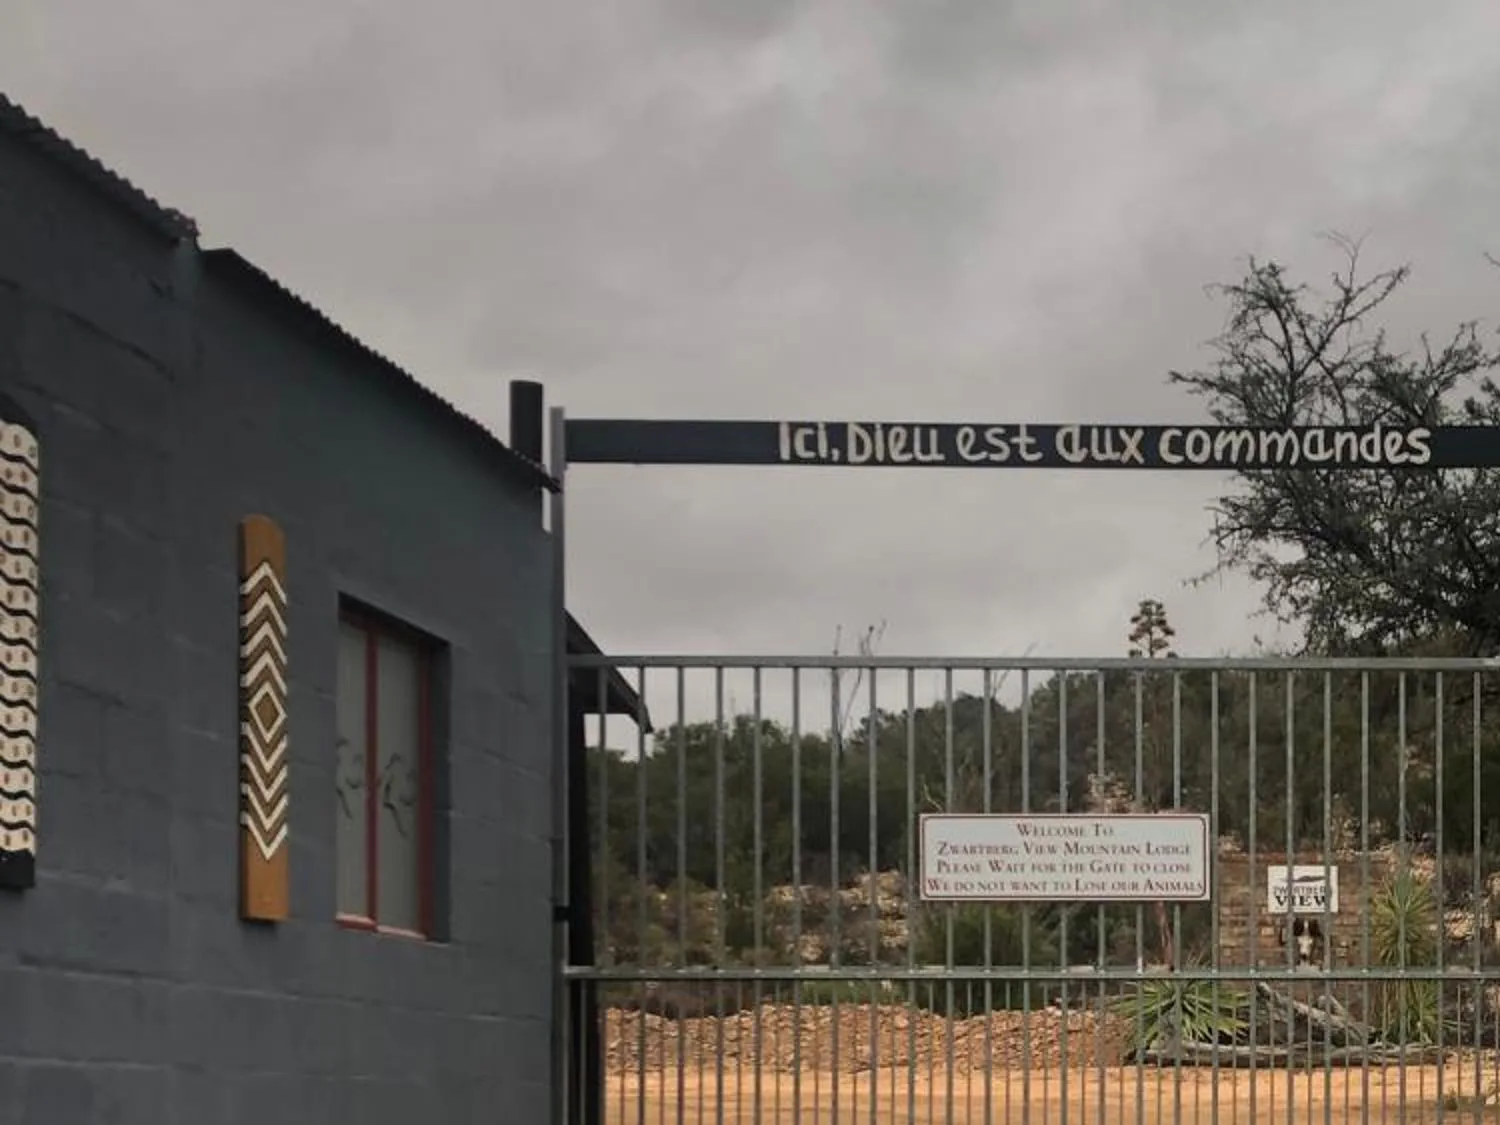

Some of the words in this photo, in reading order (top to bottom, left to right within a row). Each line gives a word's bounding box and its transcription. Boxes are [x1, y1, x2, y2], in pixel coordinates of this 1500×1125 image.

[955, 425, 1045, 463] est
[1054, 425, 1144, 463] aux
[1158, 424, 1432, 466] commandes
